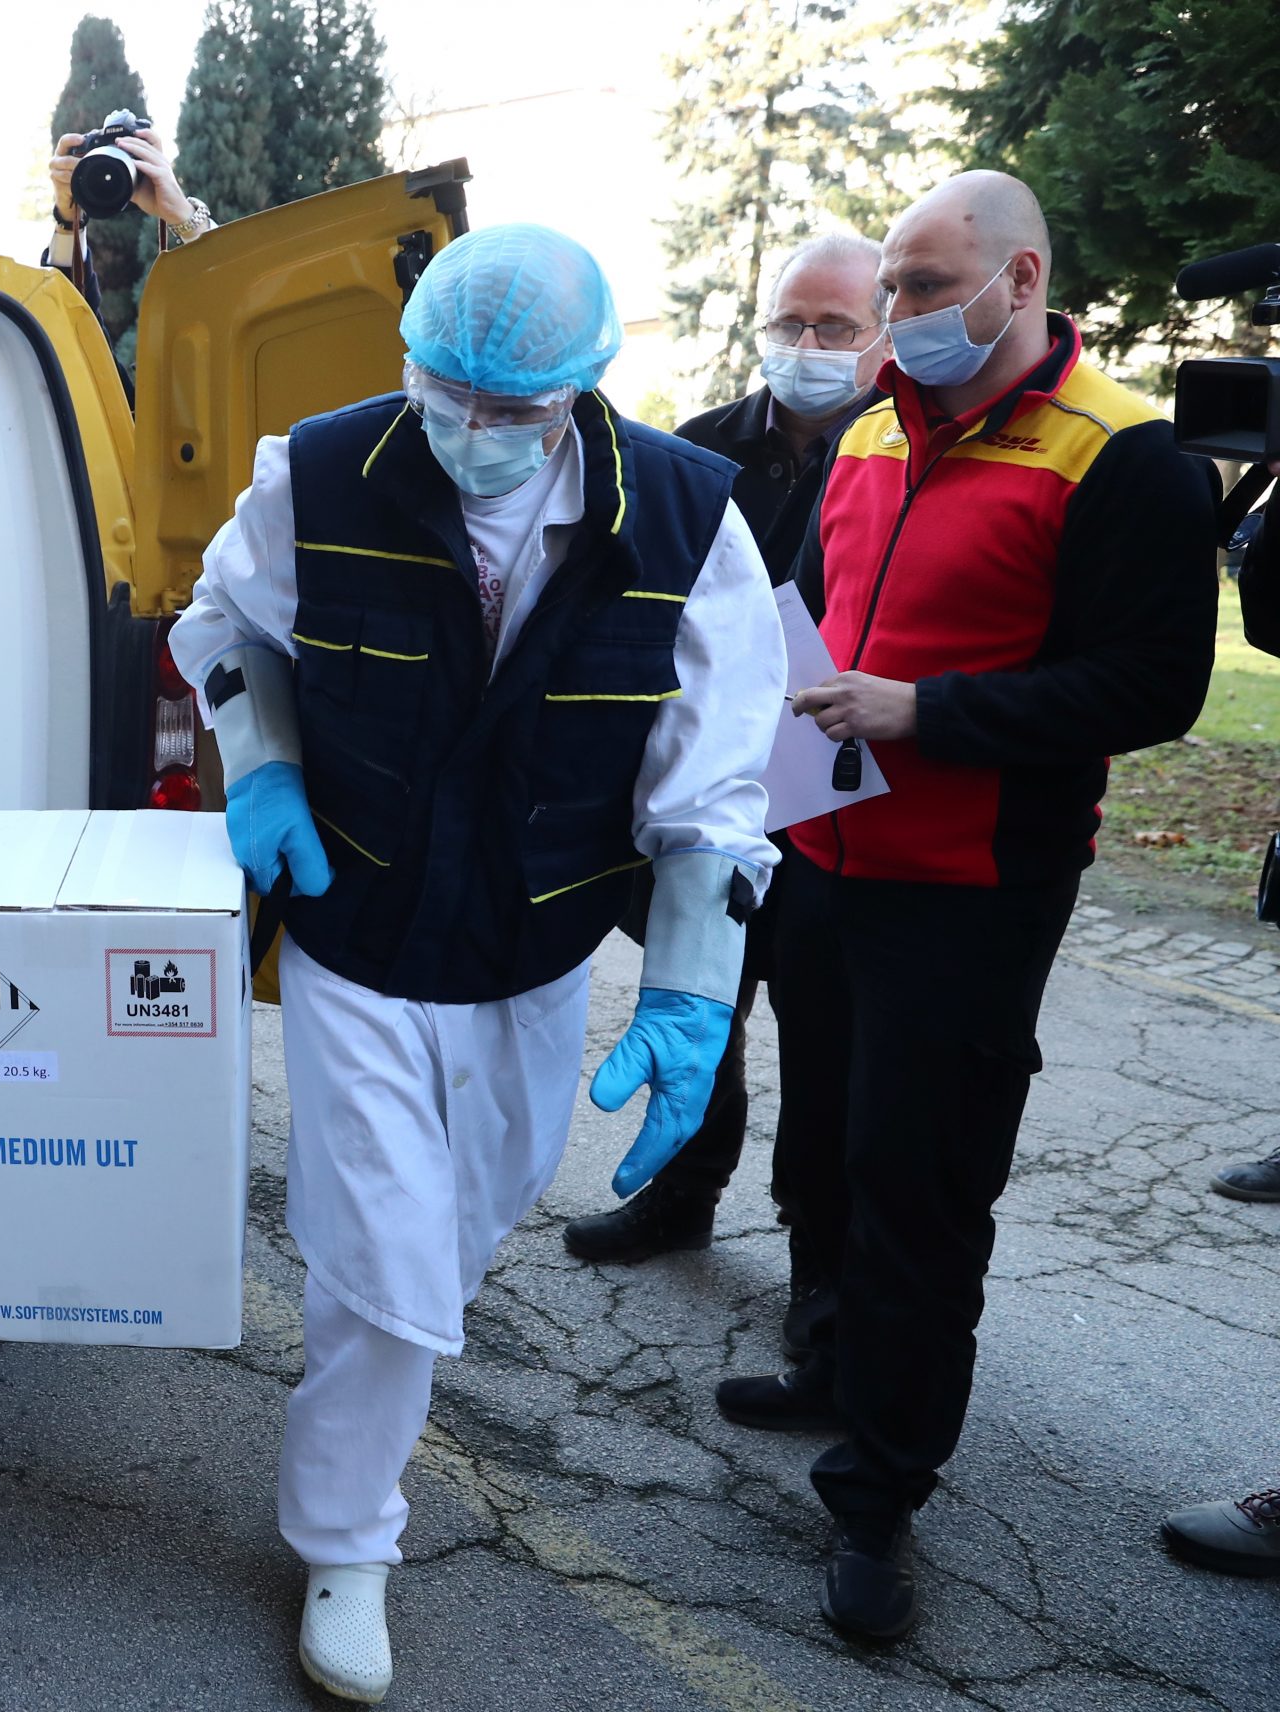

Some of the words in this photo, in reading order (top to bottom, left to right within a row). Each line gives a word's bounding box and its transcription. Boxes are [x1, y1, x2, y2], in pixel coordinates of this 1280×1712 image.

[126, 1003, 189, 1018] UN3481
[3, 1066, 29, 1077] 20.5
[33, 1066, 50, 1079] kg.
[96, 1139, 138, 1167] ULT
